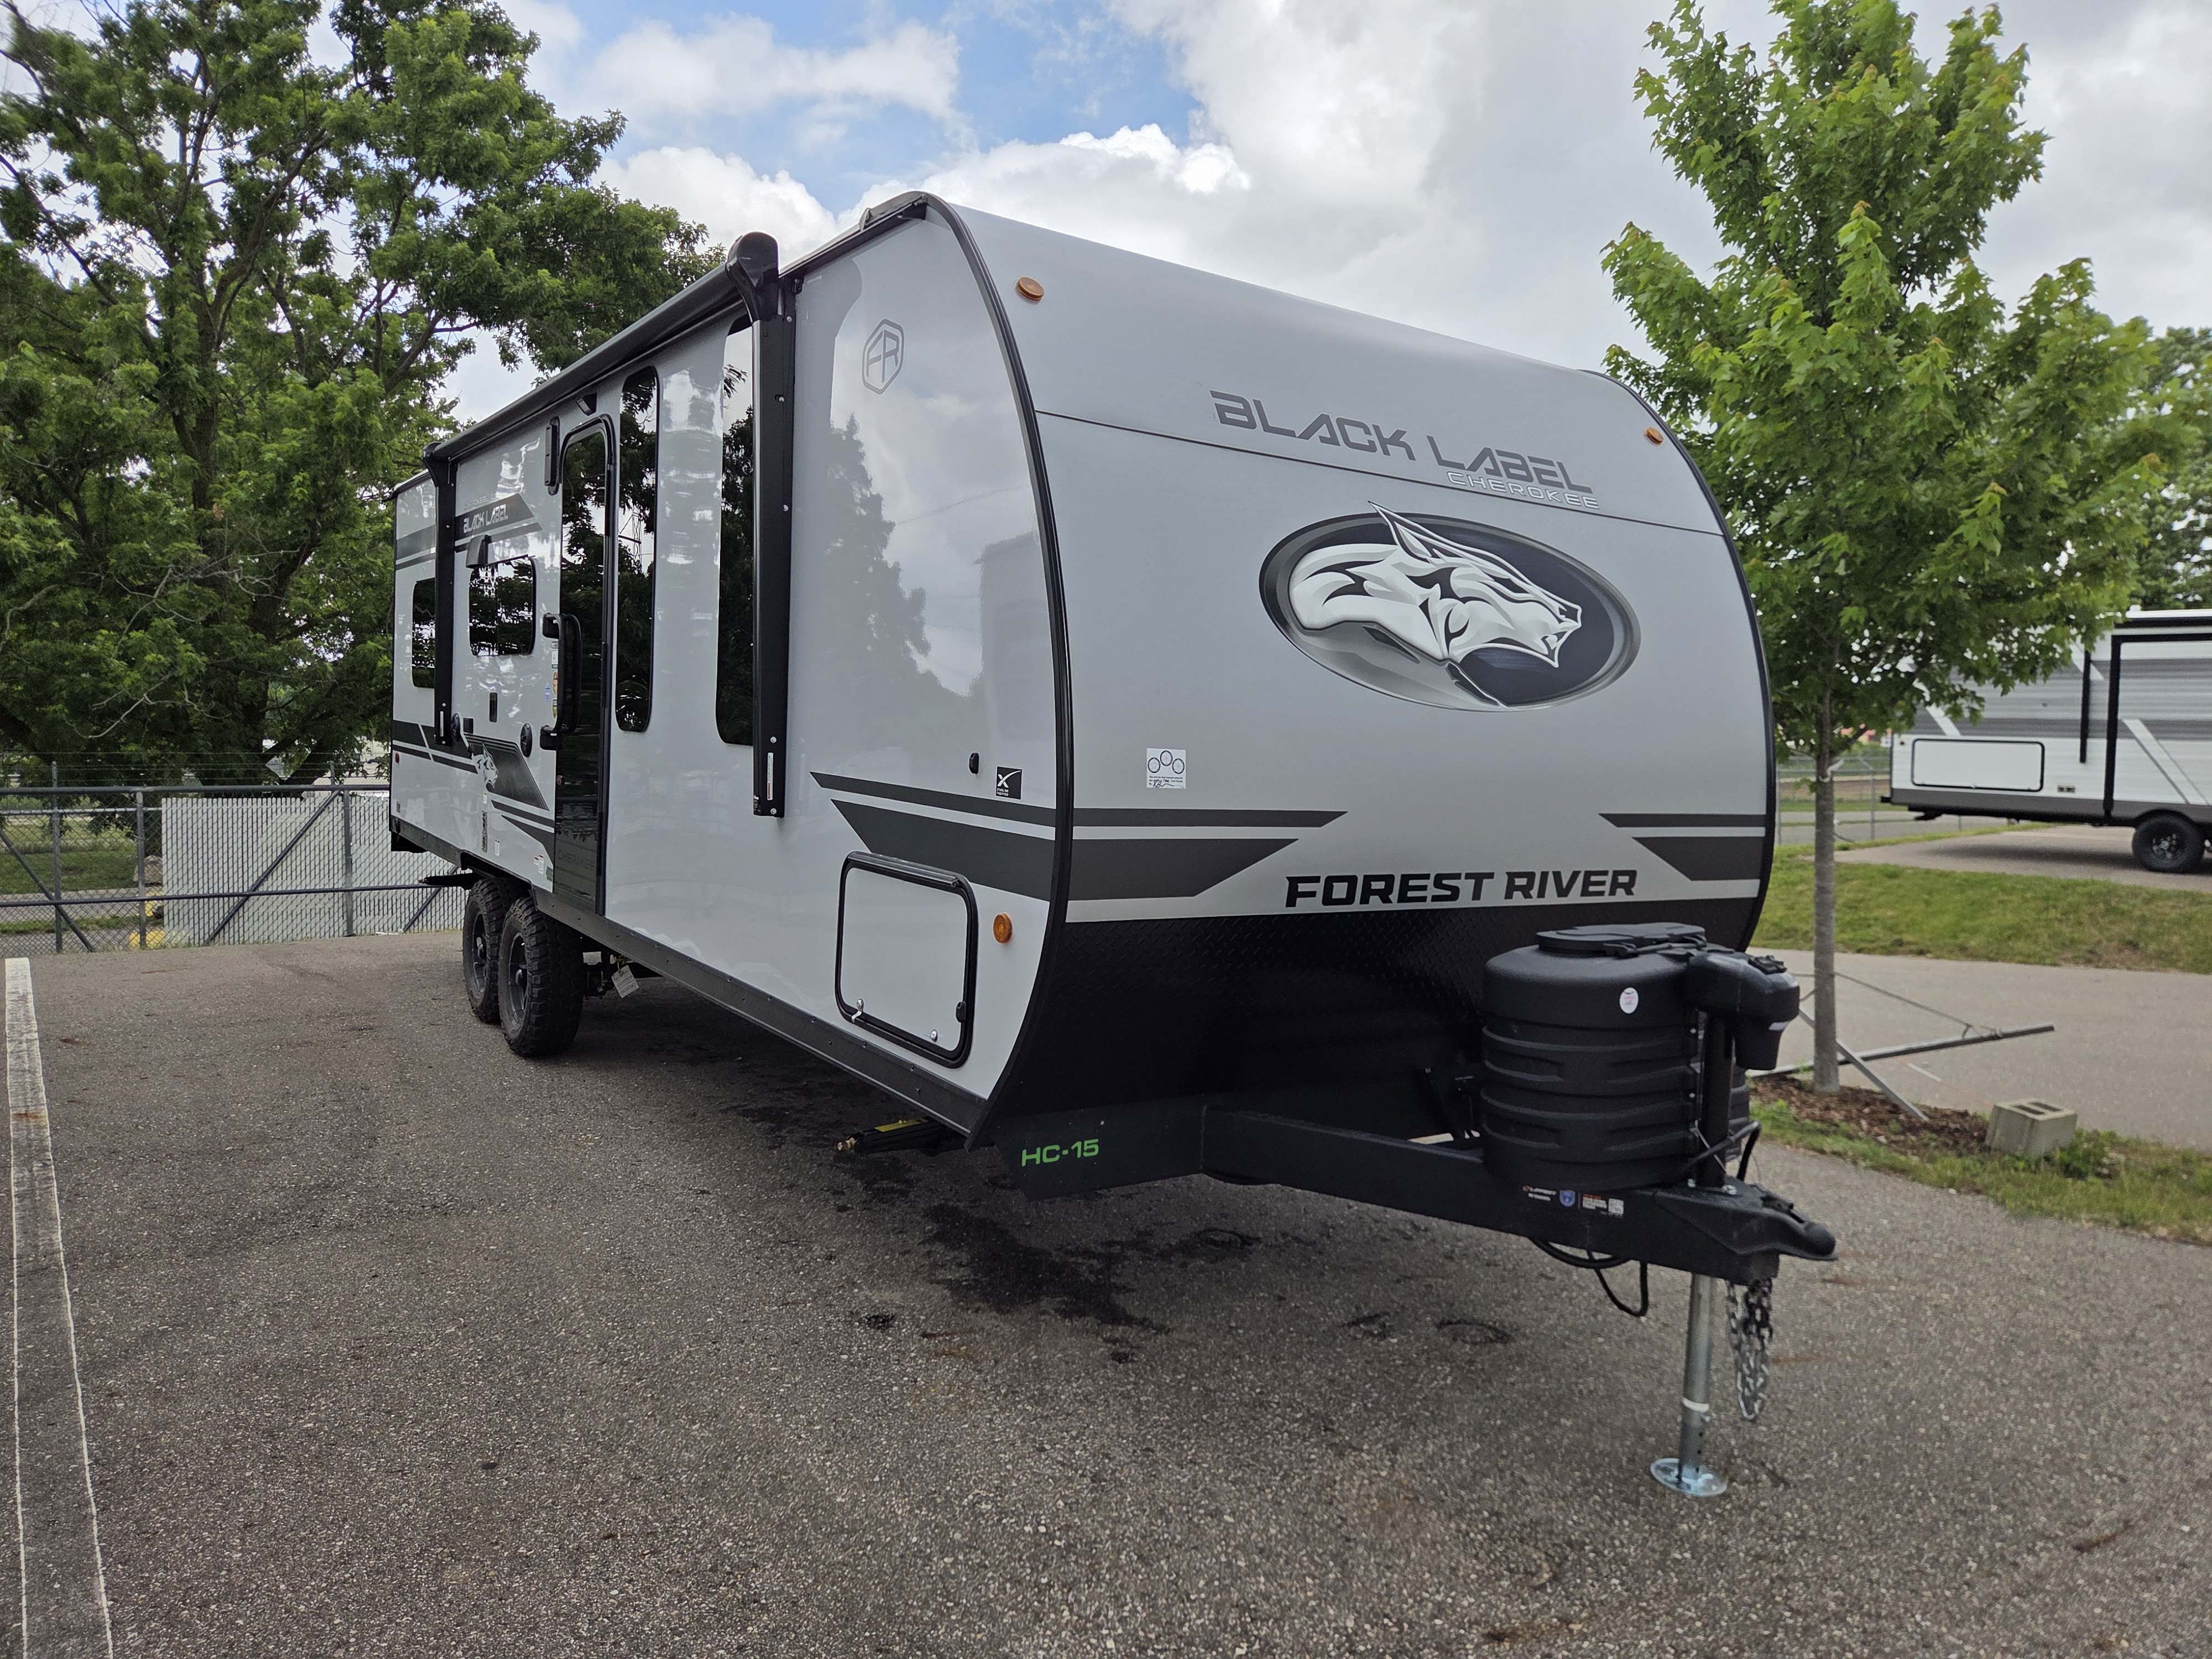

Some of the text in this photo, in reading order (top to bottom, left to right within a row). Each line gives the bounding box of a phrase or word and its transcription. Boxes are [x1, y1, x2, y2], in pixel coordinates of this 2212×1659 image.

[1210, 390, 1593, 494] BLACK LABEL
[1447, 471, 1599, 510] CHEROKEE
[463, 504, 508, 533] BLACK LABEL
[1285, 870, 1637, 907] FOREST RIVER
[1021, 1139, 1099, 1167] HC-15
